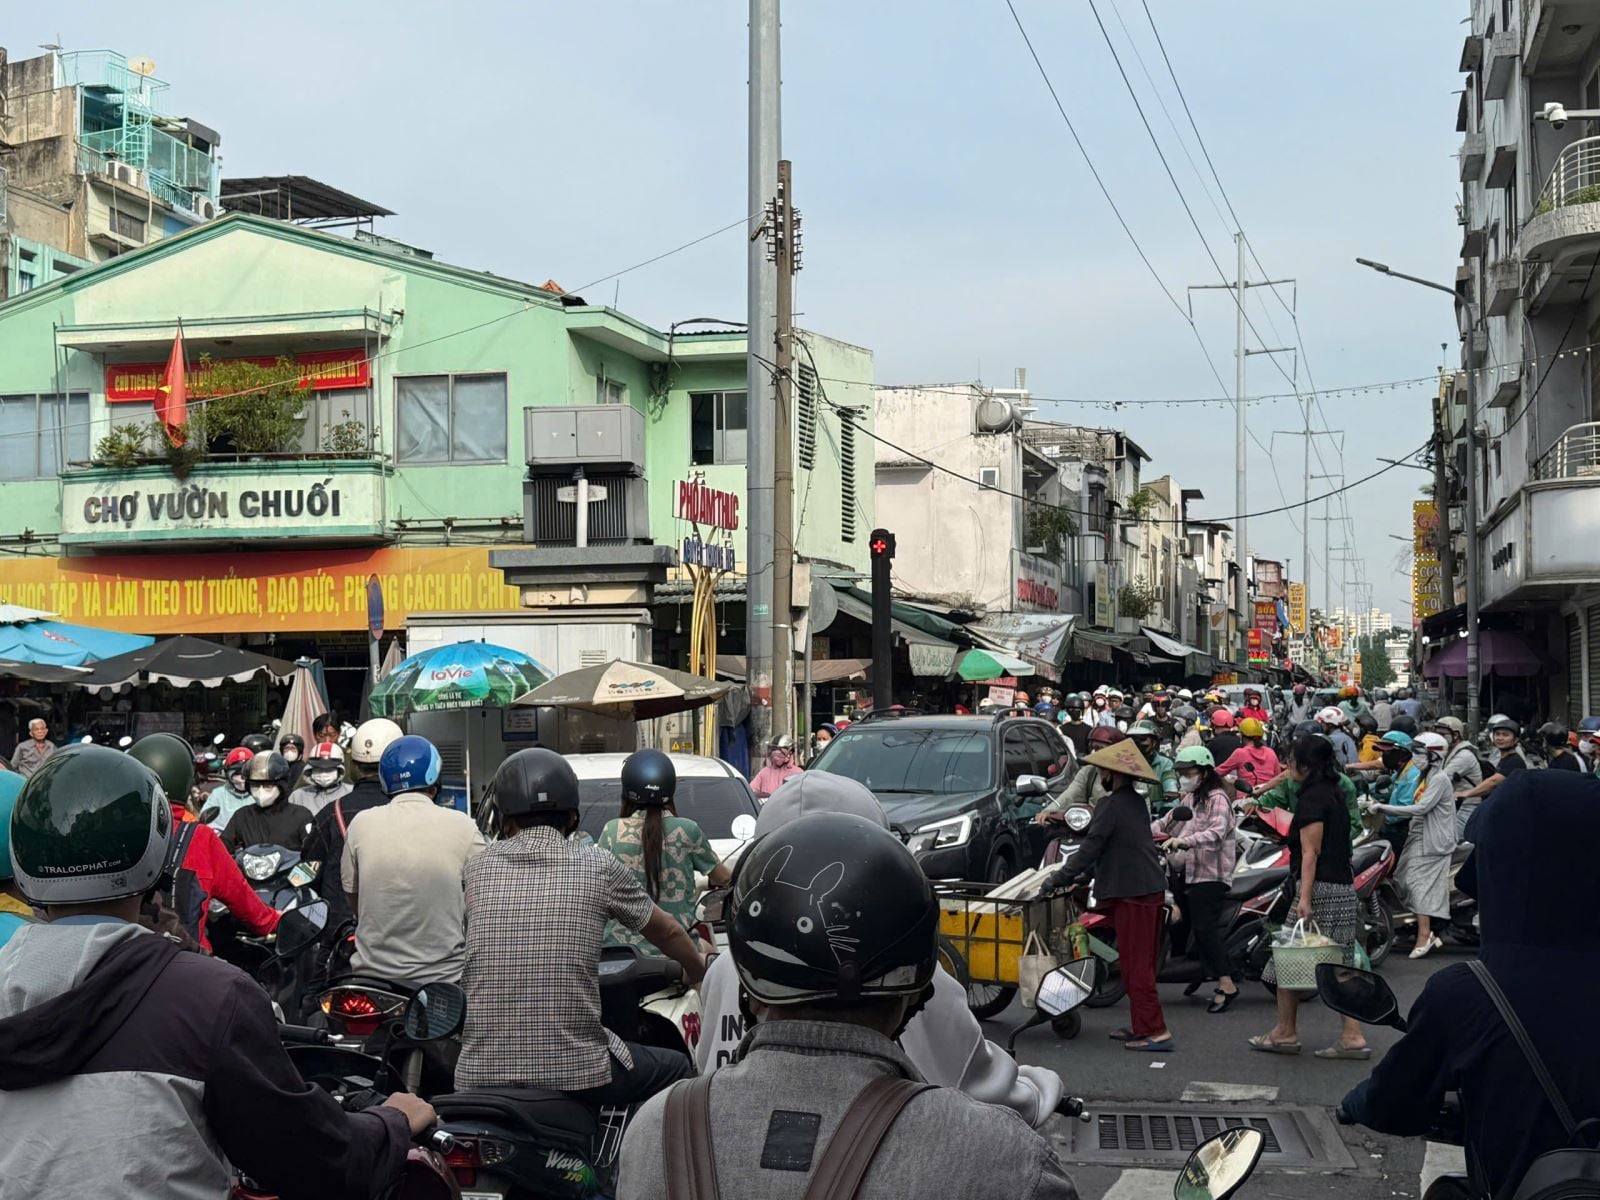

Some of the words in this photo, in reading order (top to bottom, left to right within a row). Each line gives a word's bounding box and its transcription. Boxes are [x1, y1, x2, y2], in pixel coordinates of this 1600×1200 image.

[83, 490, 140, 528] CHỢ
[147, 484, 228, 520] VƯỜN
[239, 478, 340, 518] CHUỐI
[50, 576, 77, 623] TẬP
[82, 574, 102, 617] VÀ
[106, 573, 138, 617] LÀM
[143, 580, 180, 616] THEO
[184, 576, 205, 615] TƯ
[207, 565, 263, 618] TƯỞNG,
[267, 576, 298, 621] ĐẠO
[303, 568, 339, 616] ĐỨC,
[344, 574, 399, 611] PHNG
[403, 566, 446, 611] CÁCH
[545, 1149, 586, 1172] Wave
